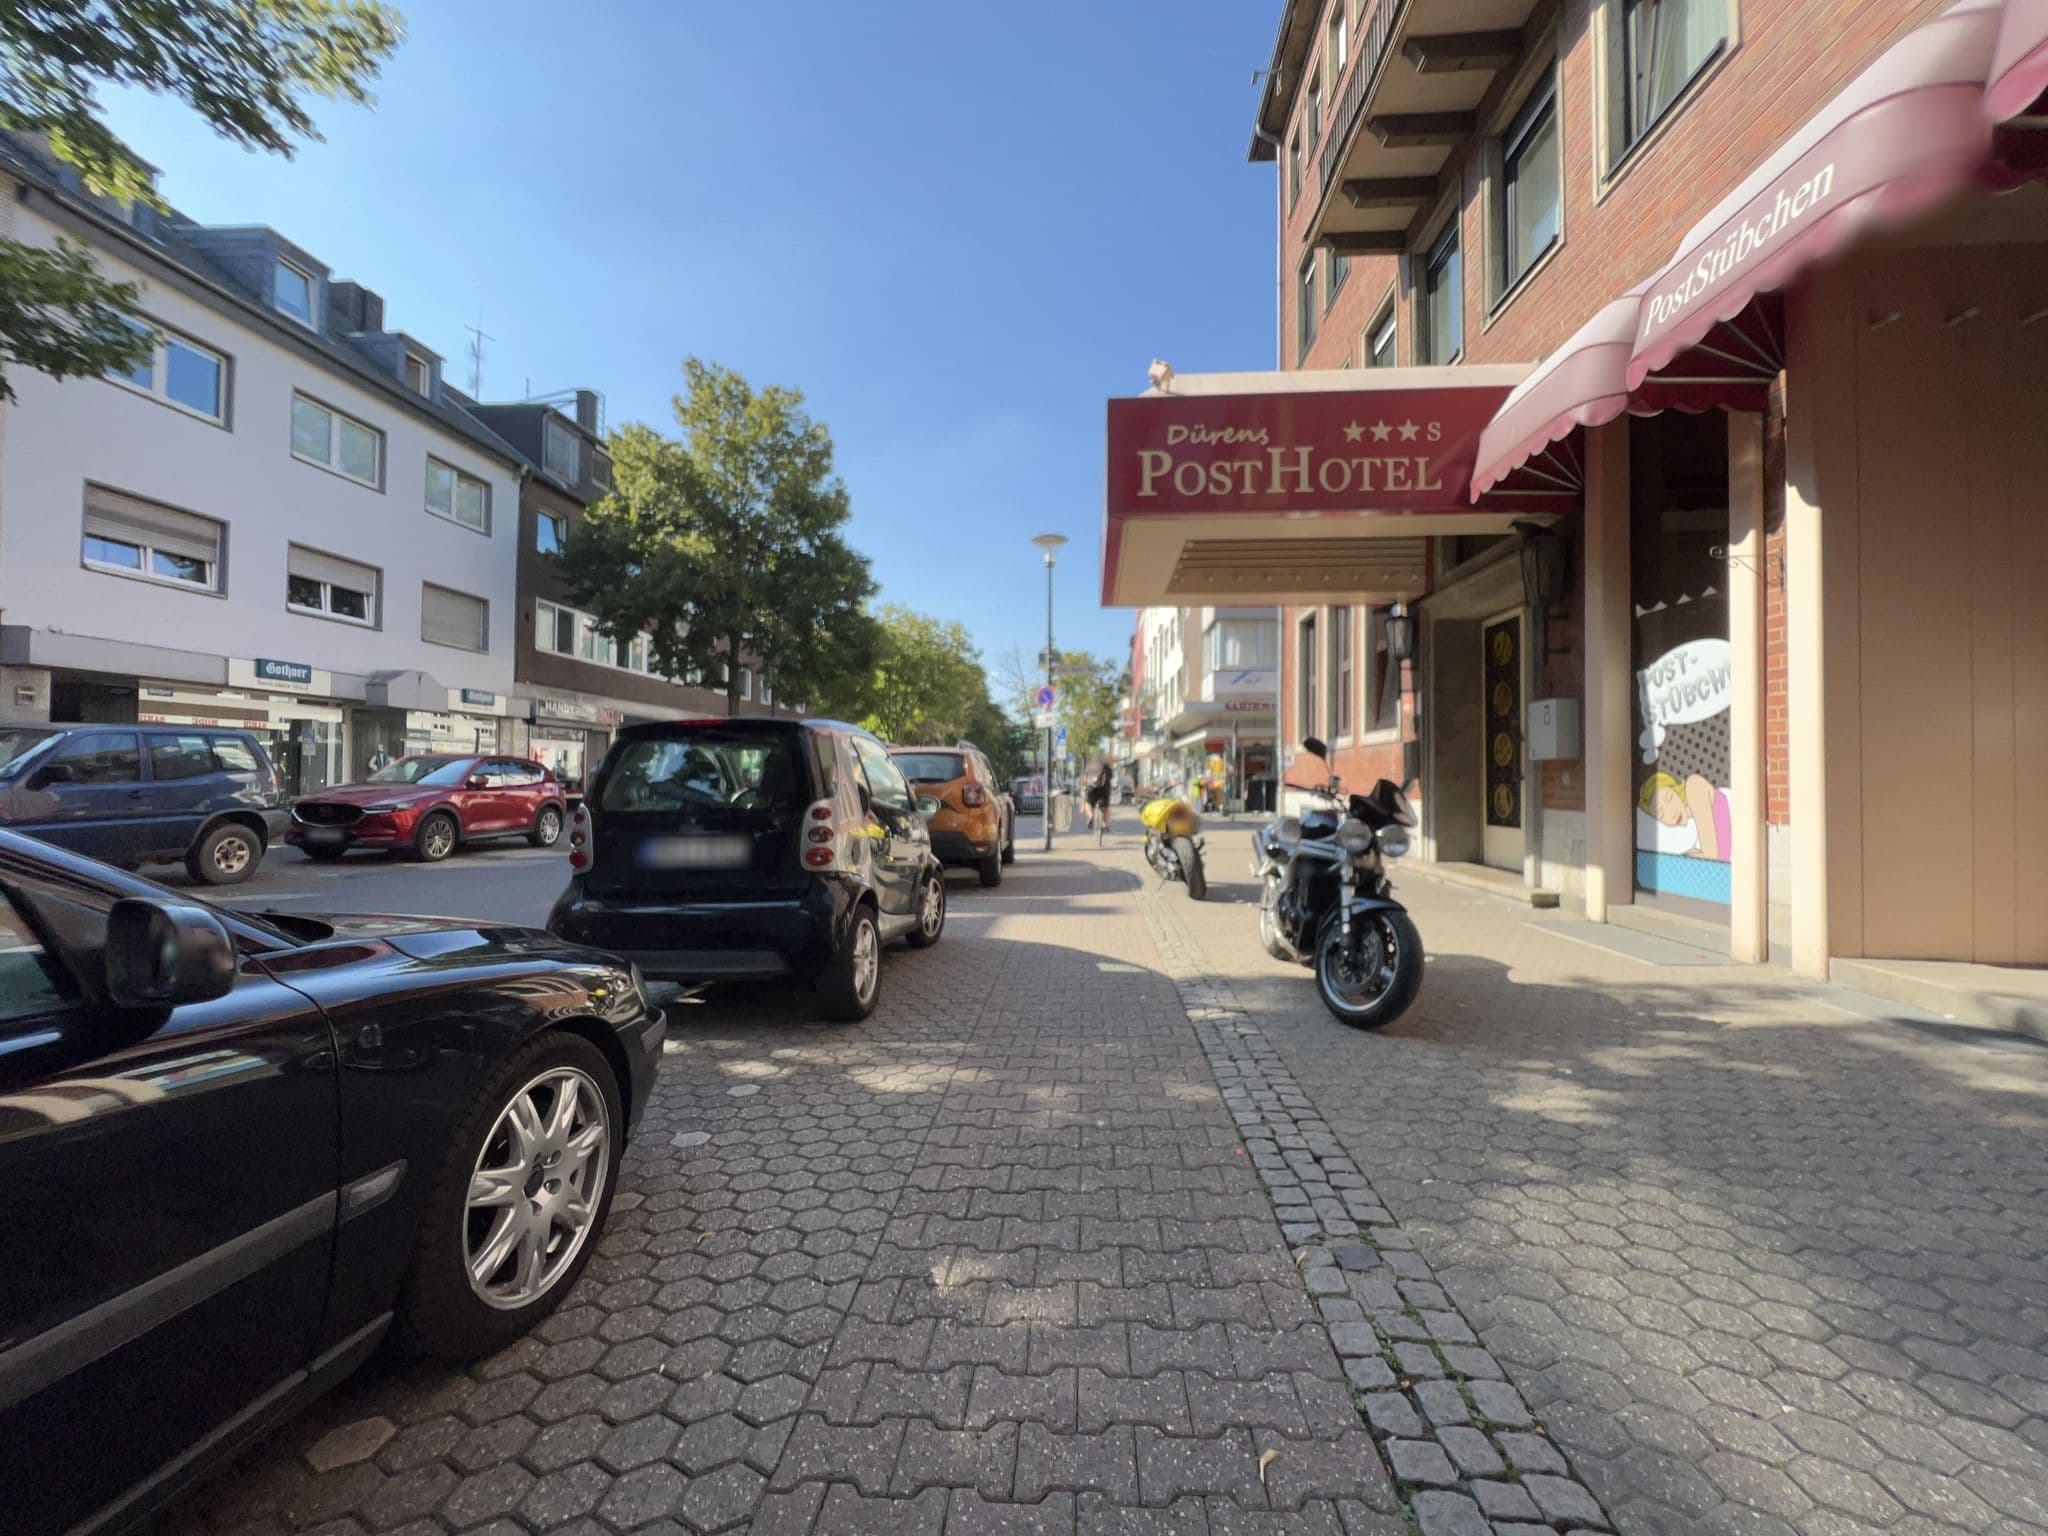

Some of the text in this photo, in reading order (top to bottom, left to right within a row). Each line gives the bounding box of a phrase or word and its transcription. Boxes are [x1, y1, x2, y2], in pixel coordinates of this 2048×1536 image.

[1643, 162, 1836, 340] PostStübchen
[1166, 423, 1271, 447] Dürens
[265, 662, 308, 679] Gothaer
